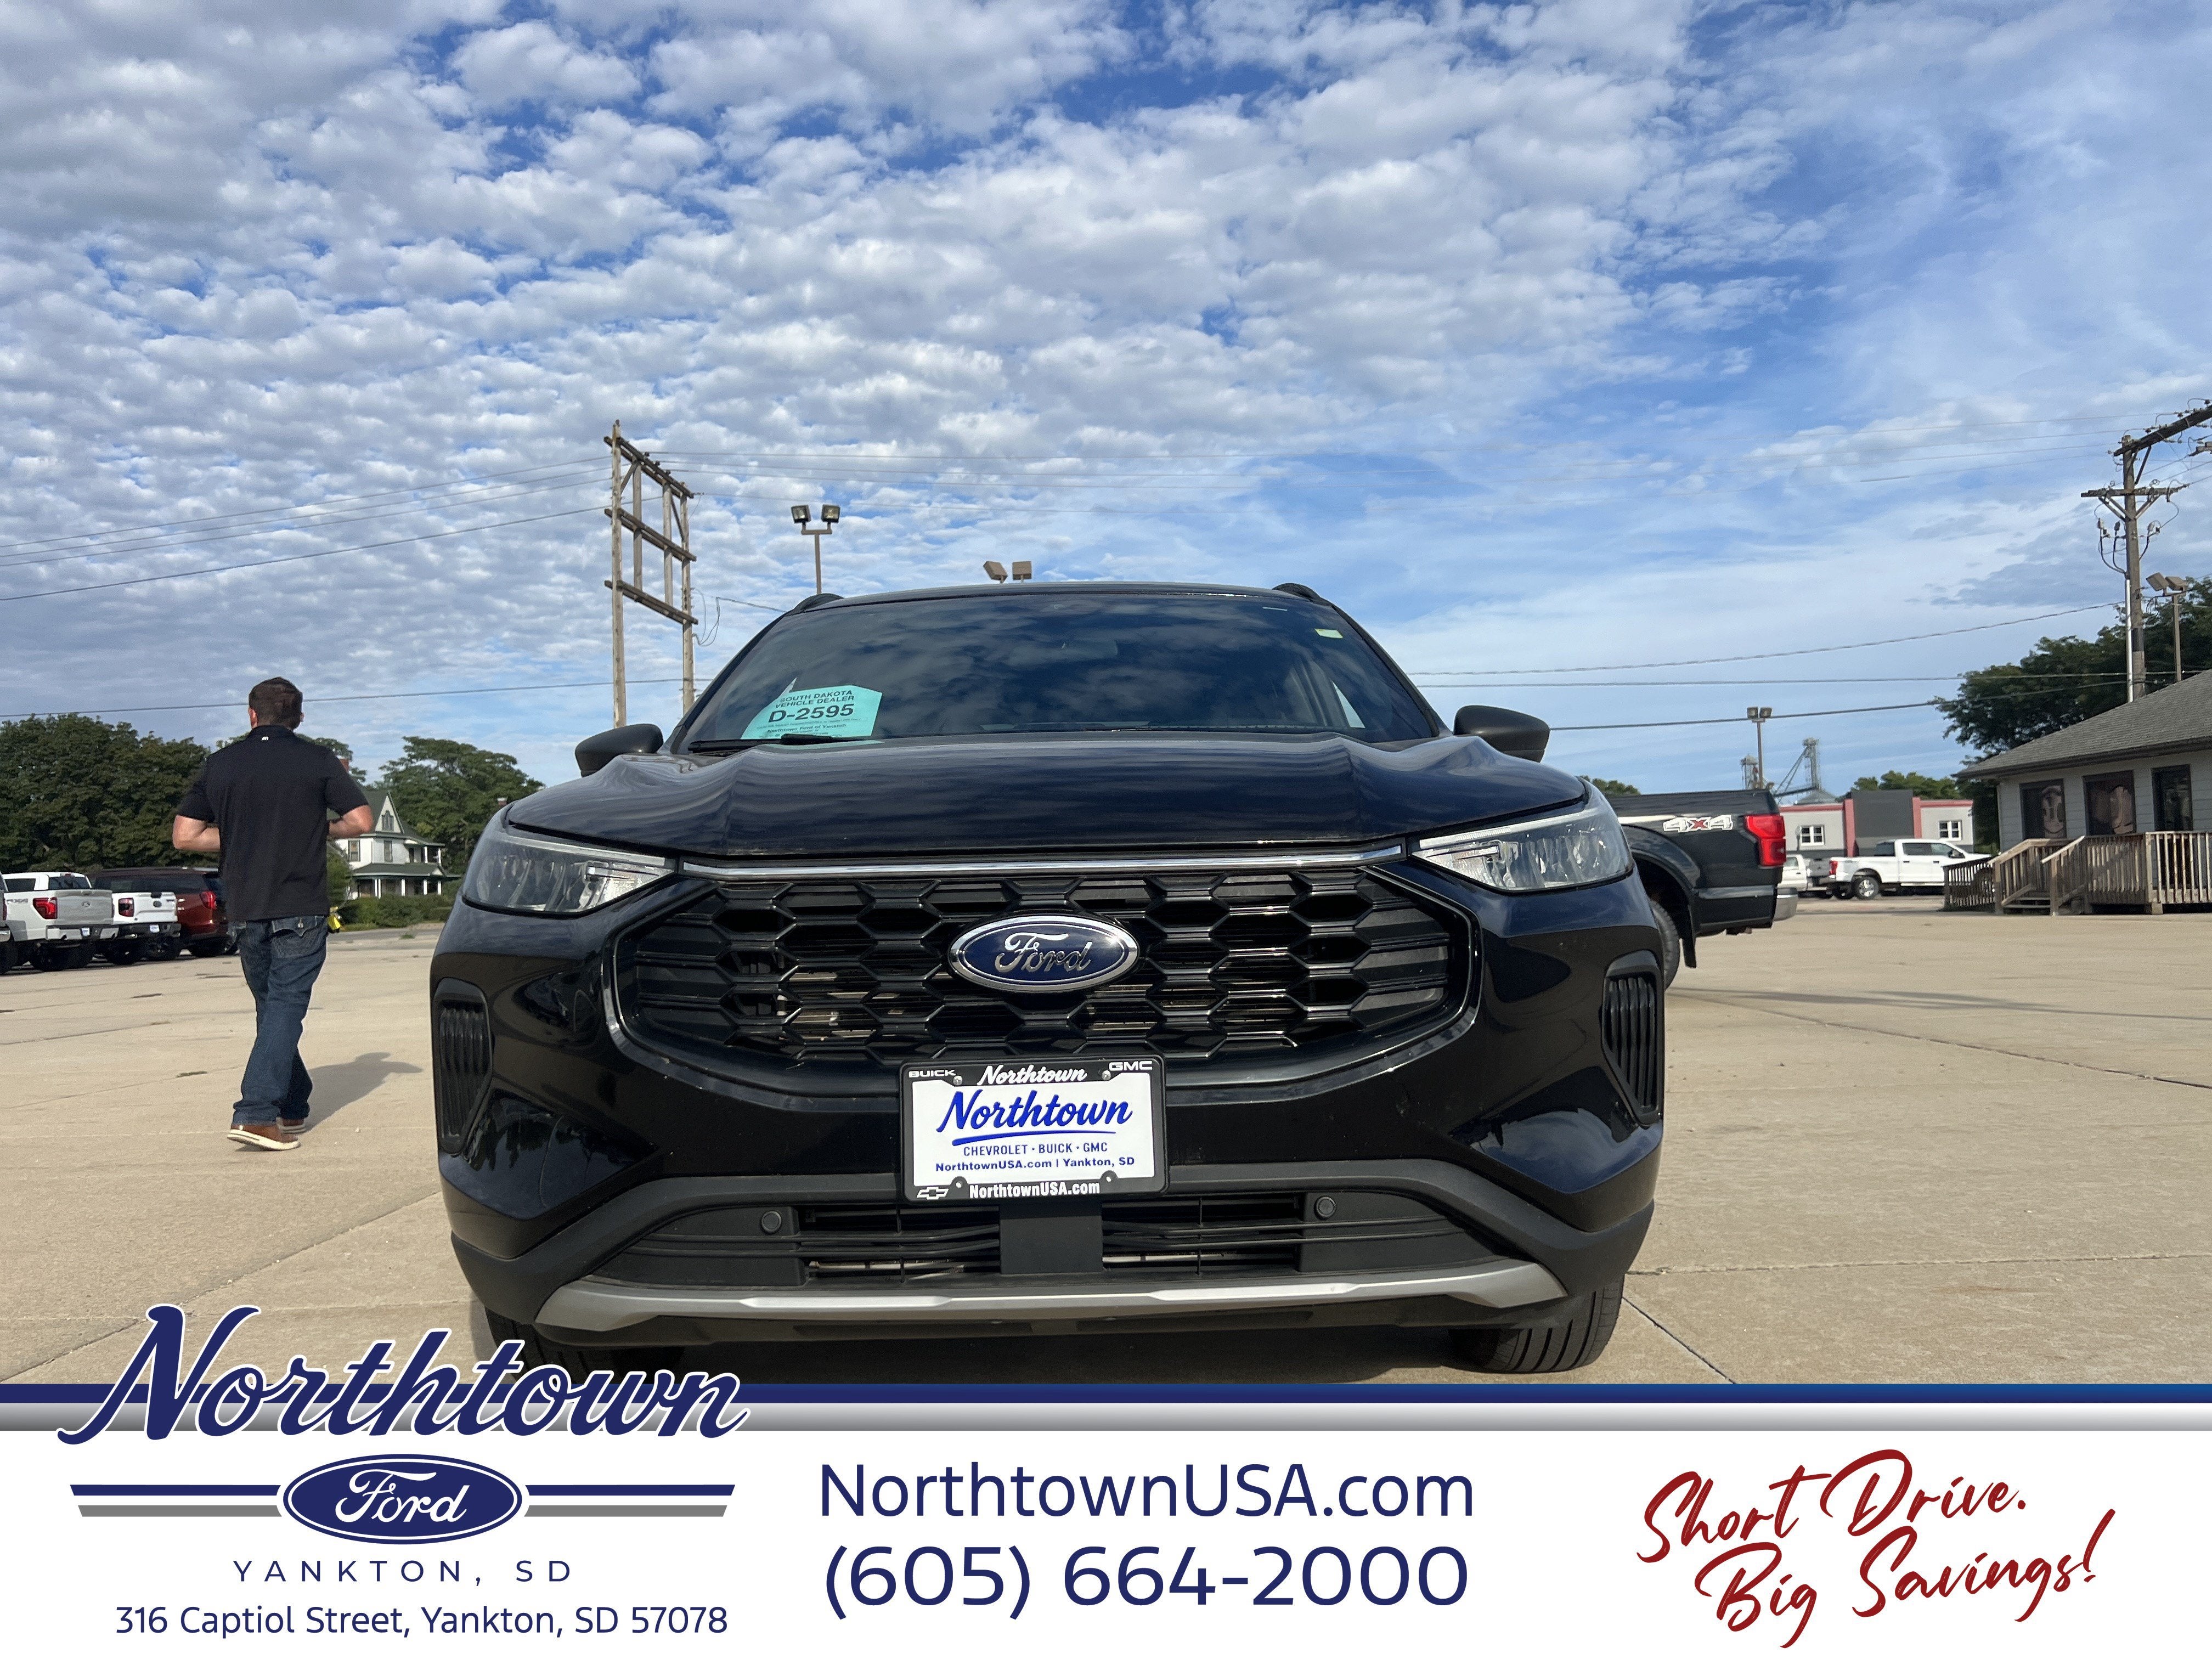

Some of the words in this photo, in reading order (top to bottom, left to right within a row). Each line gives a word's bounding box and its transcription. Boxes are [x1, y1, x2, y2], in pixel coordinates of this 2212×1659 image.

[775, 699, 814, 708] VEHICLE
[816, 696, 854, 704] DEALER
[780, 693, 811, 703] SOUTH
[814, 690, 853, 699] DAKOTA
[768, 703, 854, 723] D-2595
[994, 932, 1093, 973] Ford
[1109, 1060, 1152, 1071] GMC
[909, 1069, 956, 1078] BUICK
[977, 1064, 1087, 1086] Northtown
[936, 1089, 1133, 1133] Northtown
[963, 1144, 1028, 1156] CHEVROLET
[1039, 1143, 1073, 1154] BUICK
[1083, 1142, 1108, 1152] GMC
[935, 1160, 1052, 1171] NorthtownUSA.com
[1063, 1158, 1114, 1167] Yankton,
[1119, 1156, 1135, 1166] SD
[969, 1181, 1100, 1199] NorthtownUSA.com
